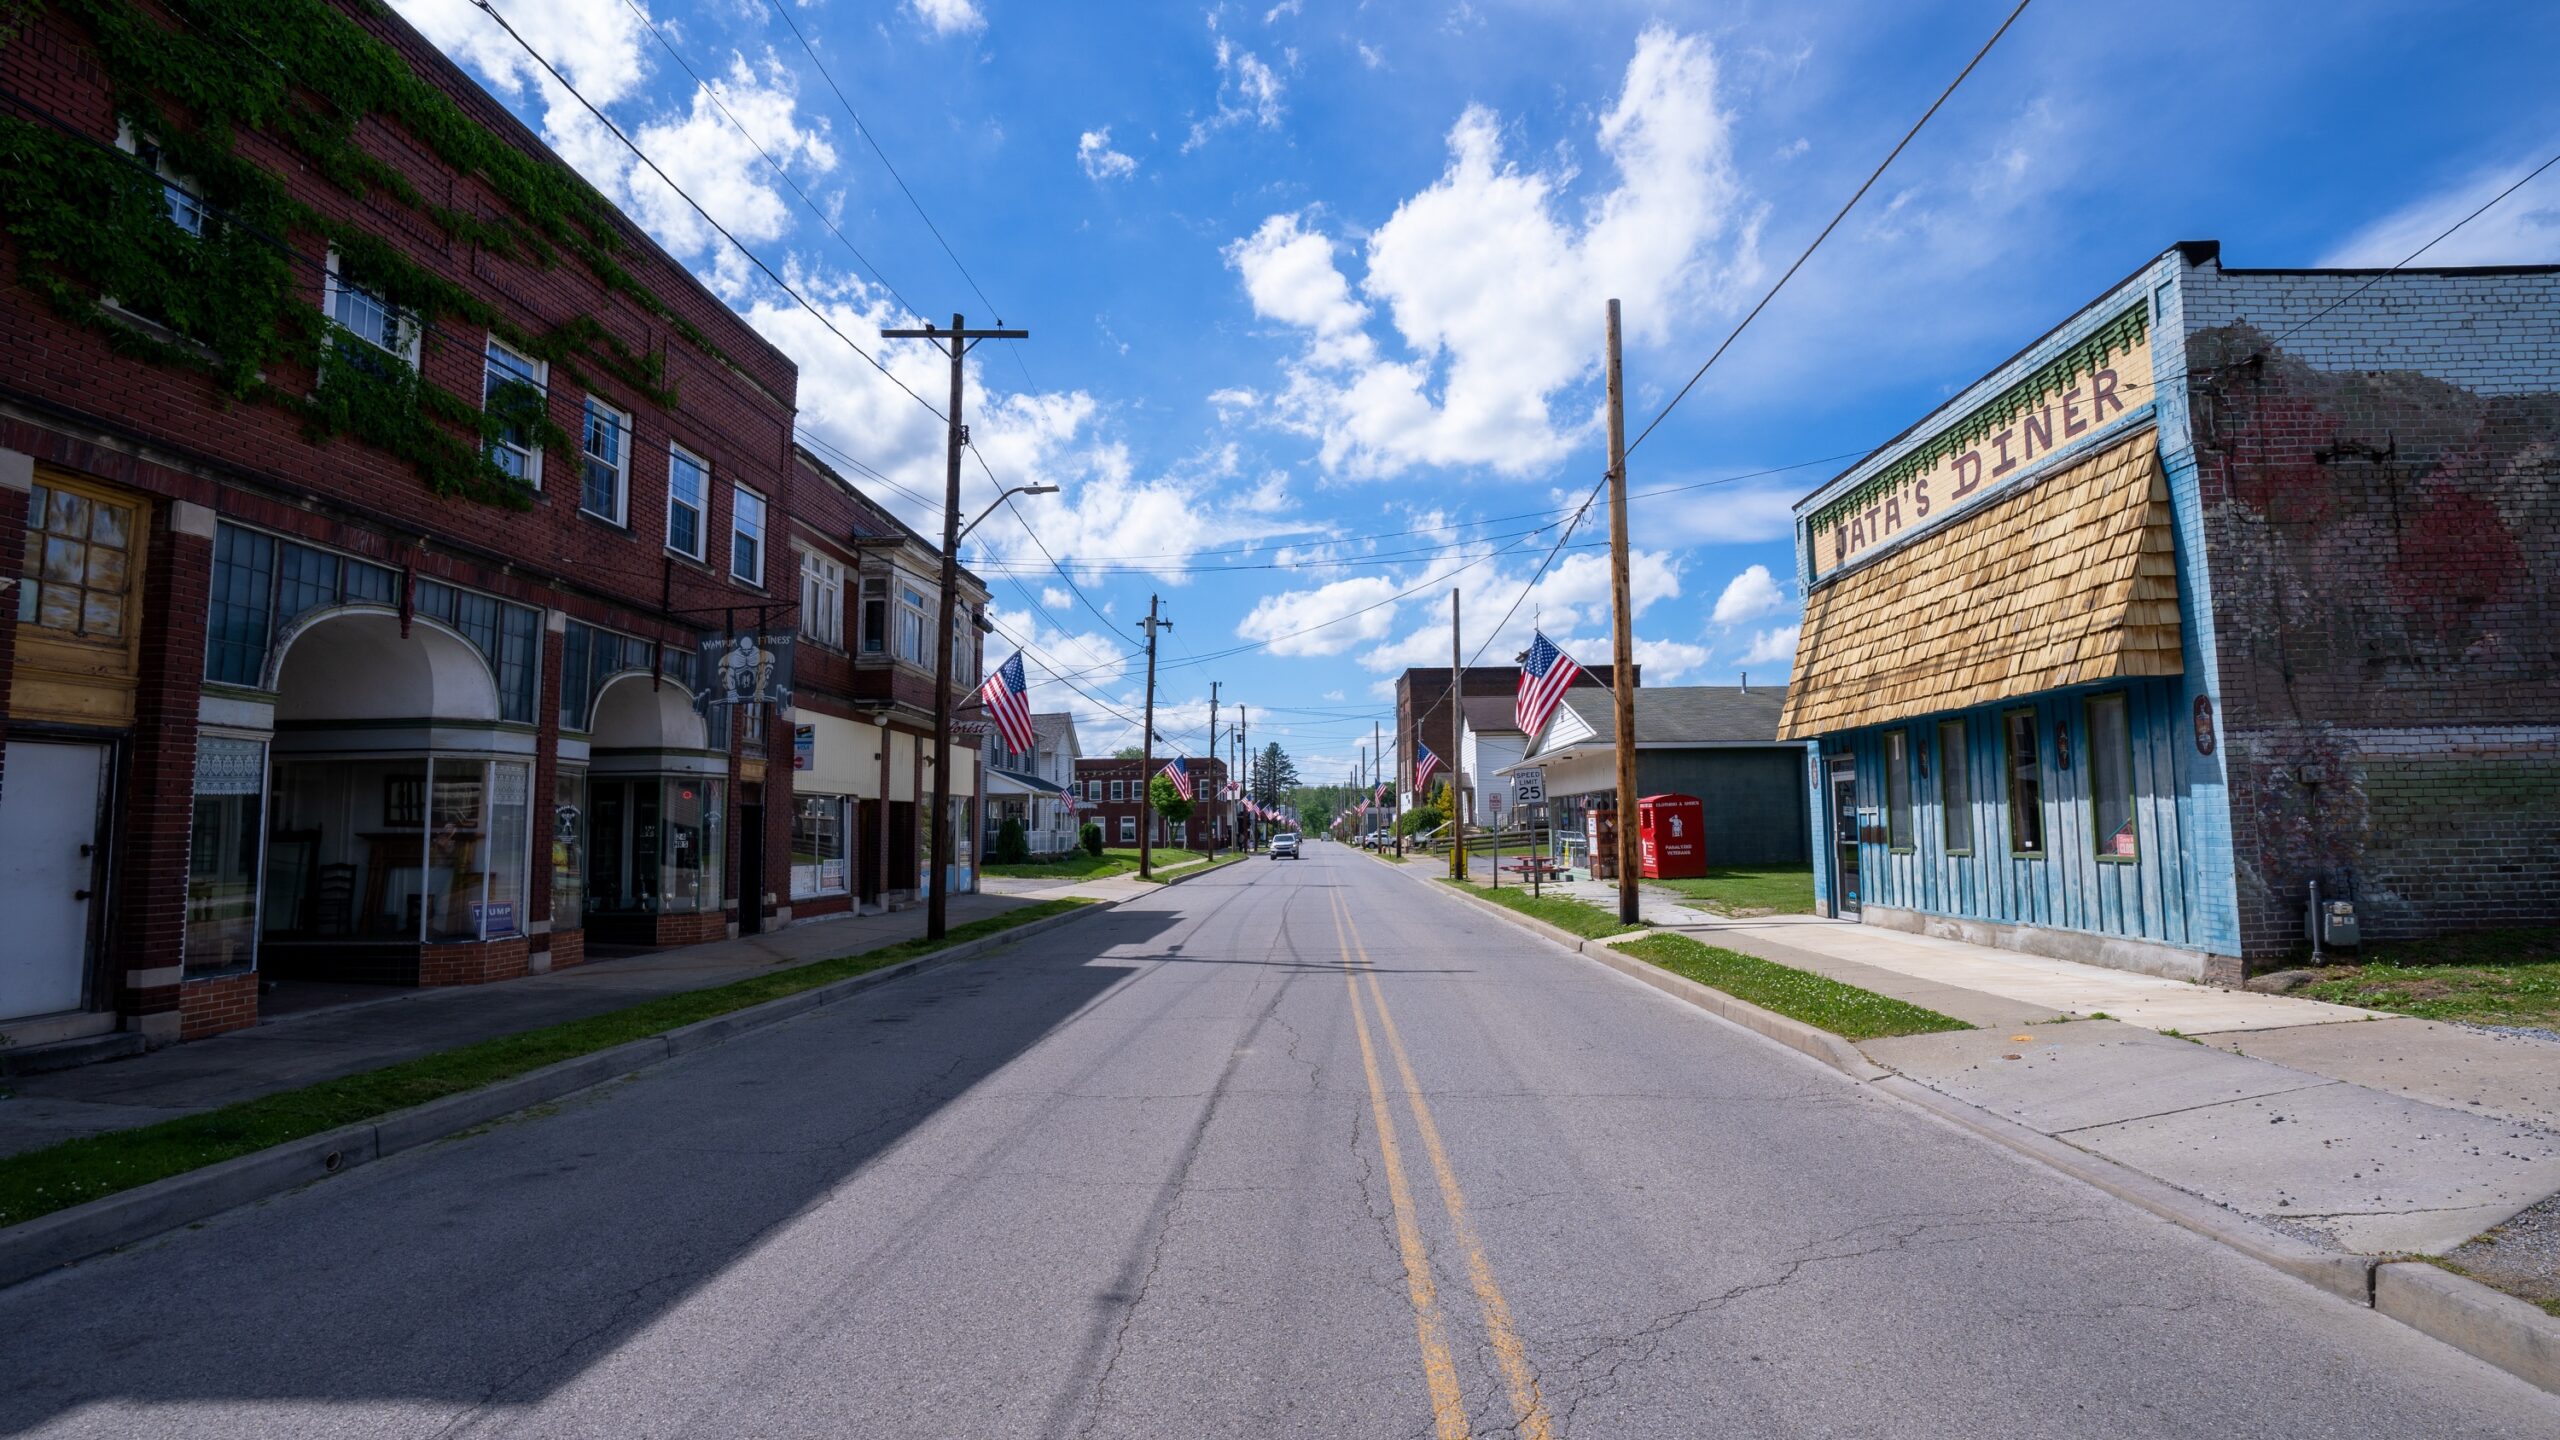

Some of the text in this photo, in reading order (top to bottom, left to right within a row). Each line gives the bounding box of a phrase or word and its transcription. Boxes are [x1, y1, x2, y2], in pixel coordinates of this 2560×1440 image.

[1836, 369, 2124, 559] JATA'S DINER
[949, 720, 992, 733] lorist
[1516, 771, 1540, 779] SPEED
[1518, 786, 1541, 800] 25
[474, 907, 511, 917] TUMP
